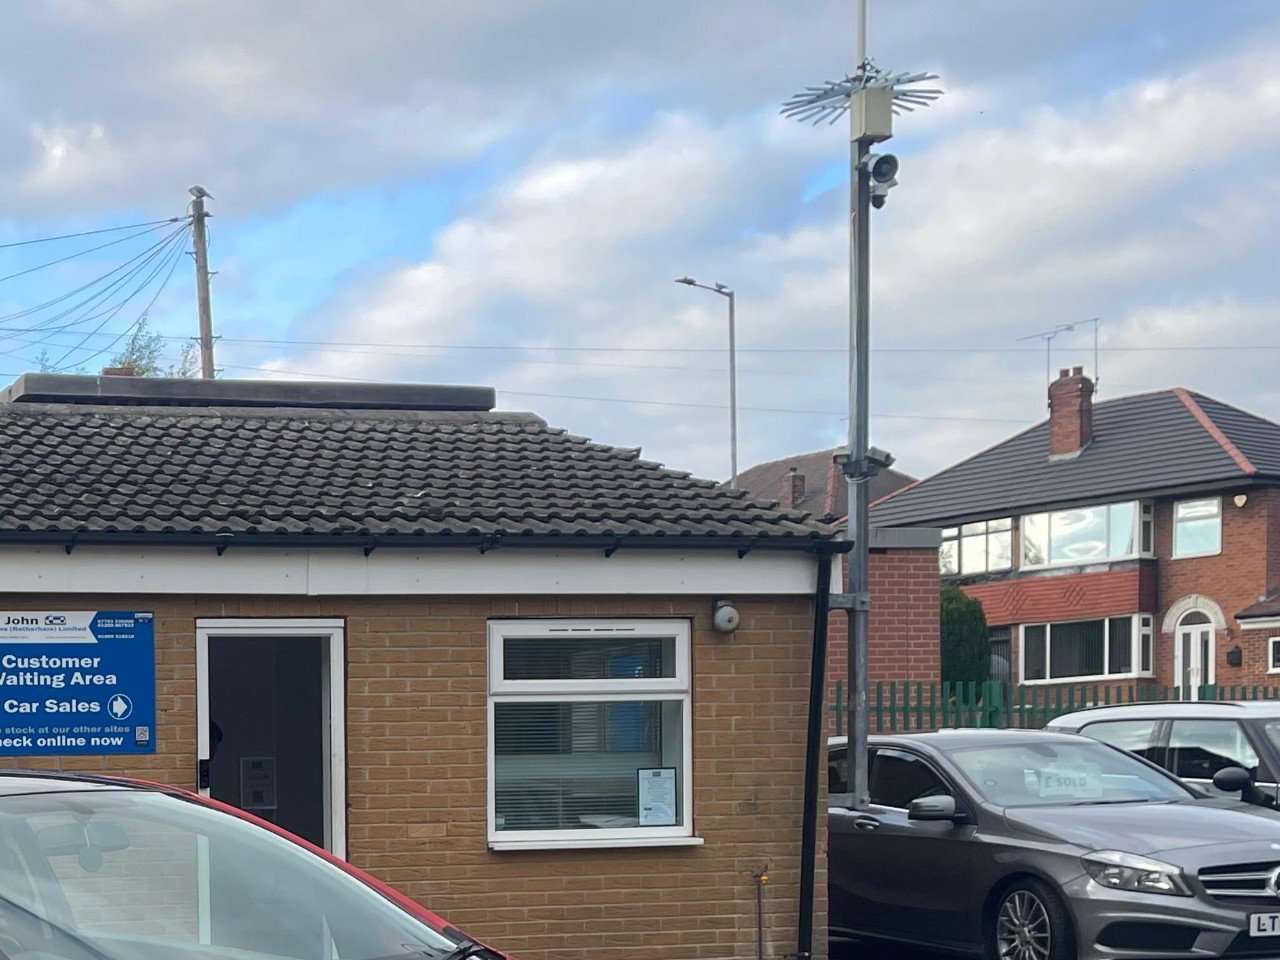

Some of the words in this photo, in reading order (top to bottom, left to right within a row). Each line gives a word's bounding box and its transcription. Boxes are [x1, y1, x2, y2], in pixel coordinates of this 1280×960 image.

[4, 615, 39, 625] John
[2, 654, 101, 669] Customer
[70, 671, 117, 686] Area
[4, 699, 40, 713] Car
[44, 699, 101, 713] Sales
[5, 725, 35, 735] stock
[38, 726, 49, 734] at
[73, 725, 101, 734] other
[104, 725, 130, 734] sites
[37, 735, 86, 747] online
[91, 736, 124, 746] now
